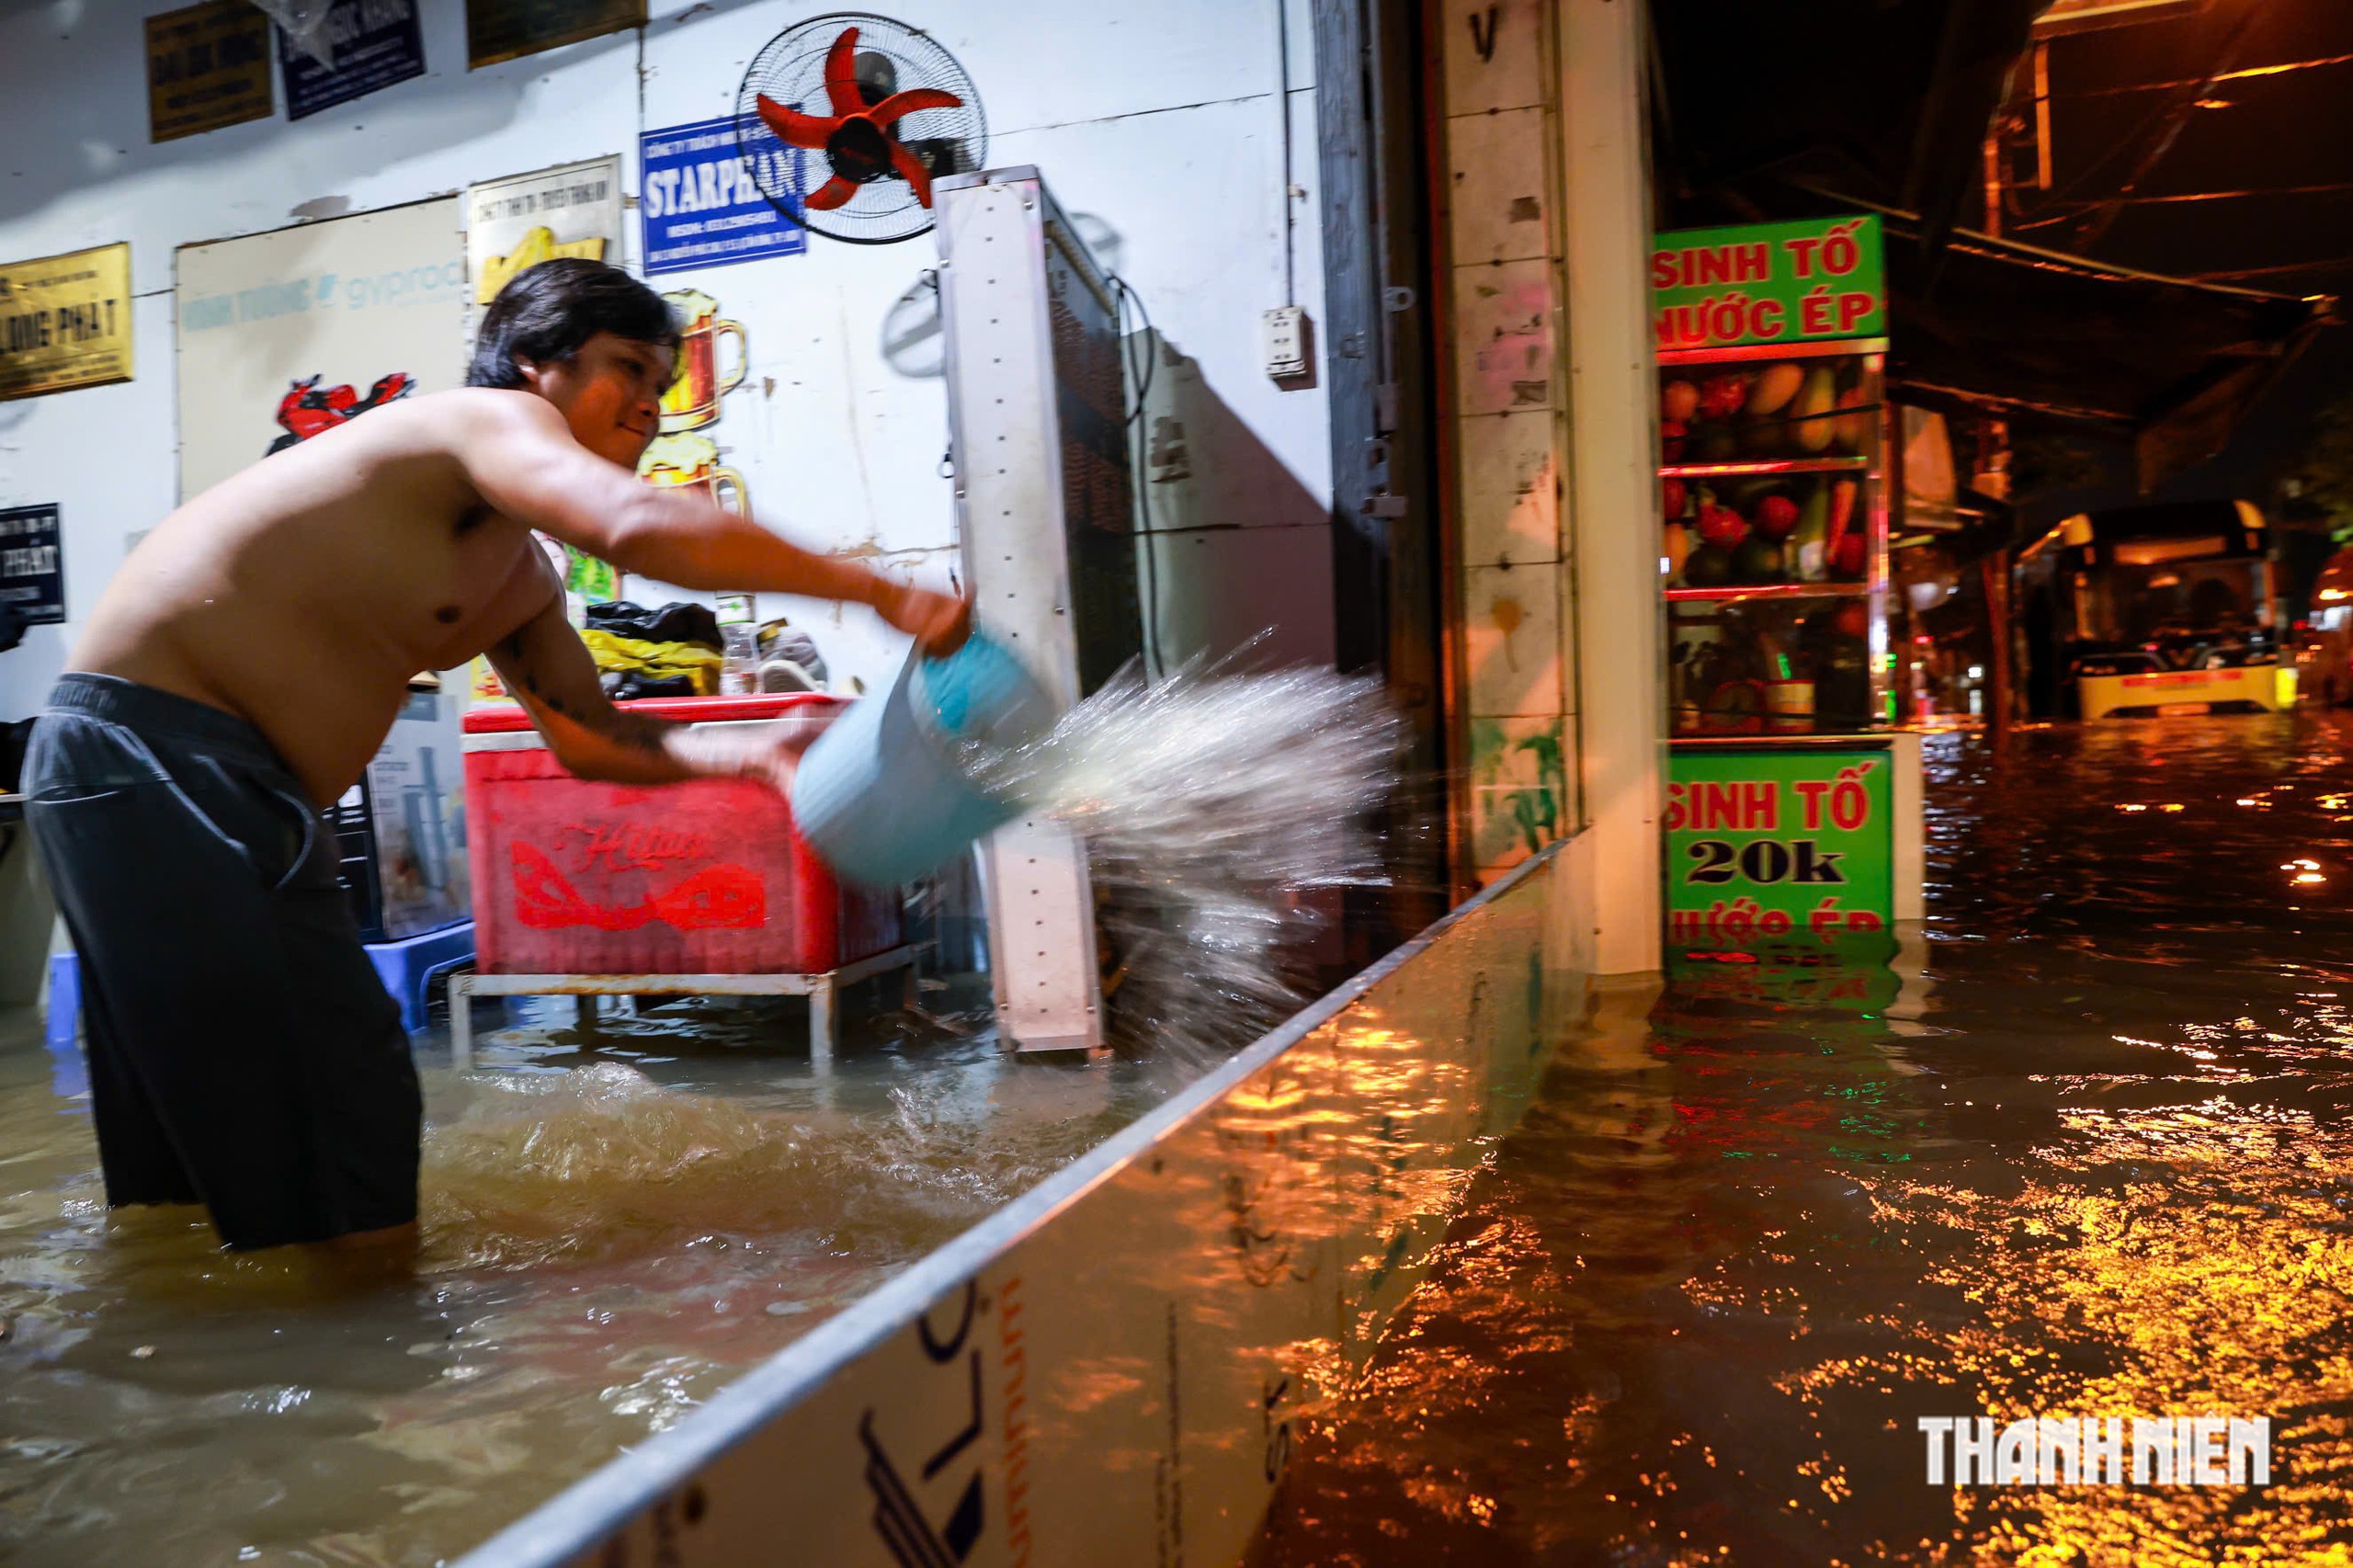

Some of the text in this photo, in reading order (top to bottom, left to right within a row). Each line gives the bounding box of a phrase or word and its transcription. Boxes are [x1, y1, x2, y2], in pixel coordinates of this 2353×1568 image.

[645, 148, 798, 219] STARPHAN
[1652, 217, 1871, 290] SINH TỐ
[1655, 284, 1875, 346] NƯỚC ÉP
[1666, 759, 1881, 832] SINH TỐ
[1685, 838, 1847, 885] 20k
